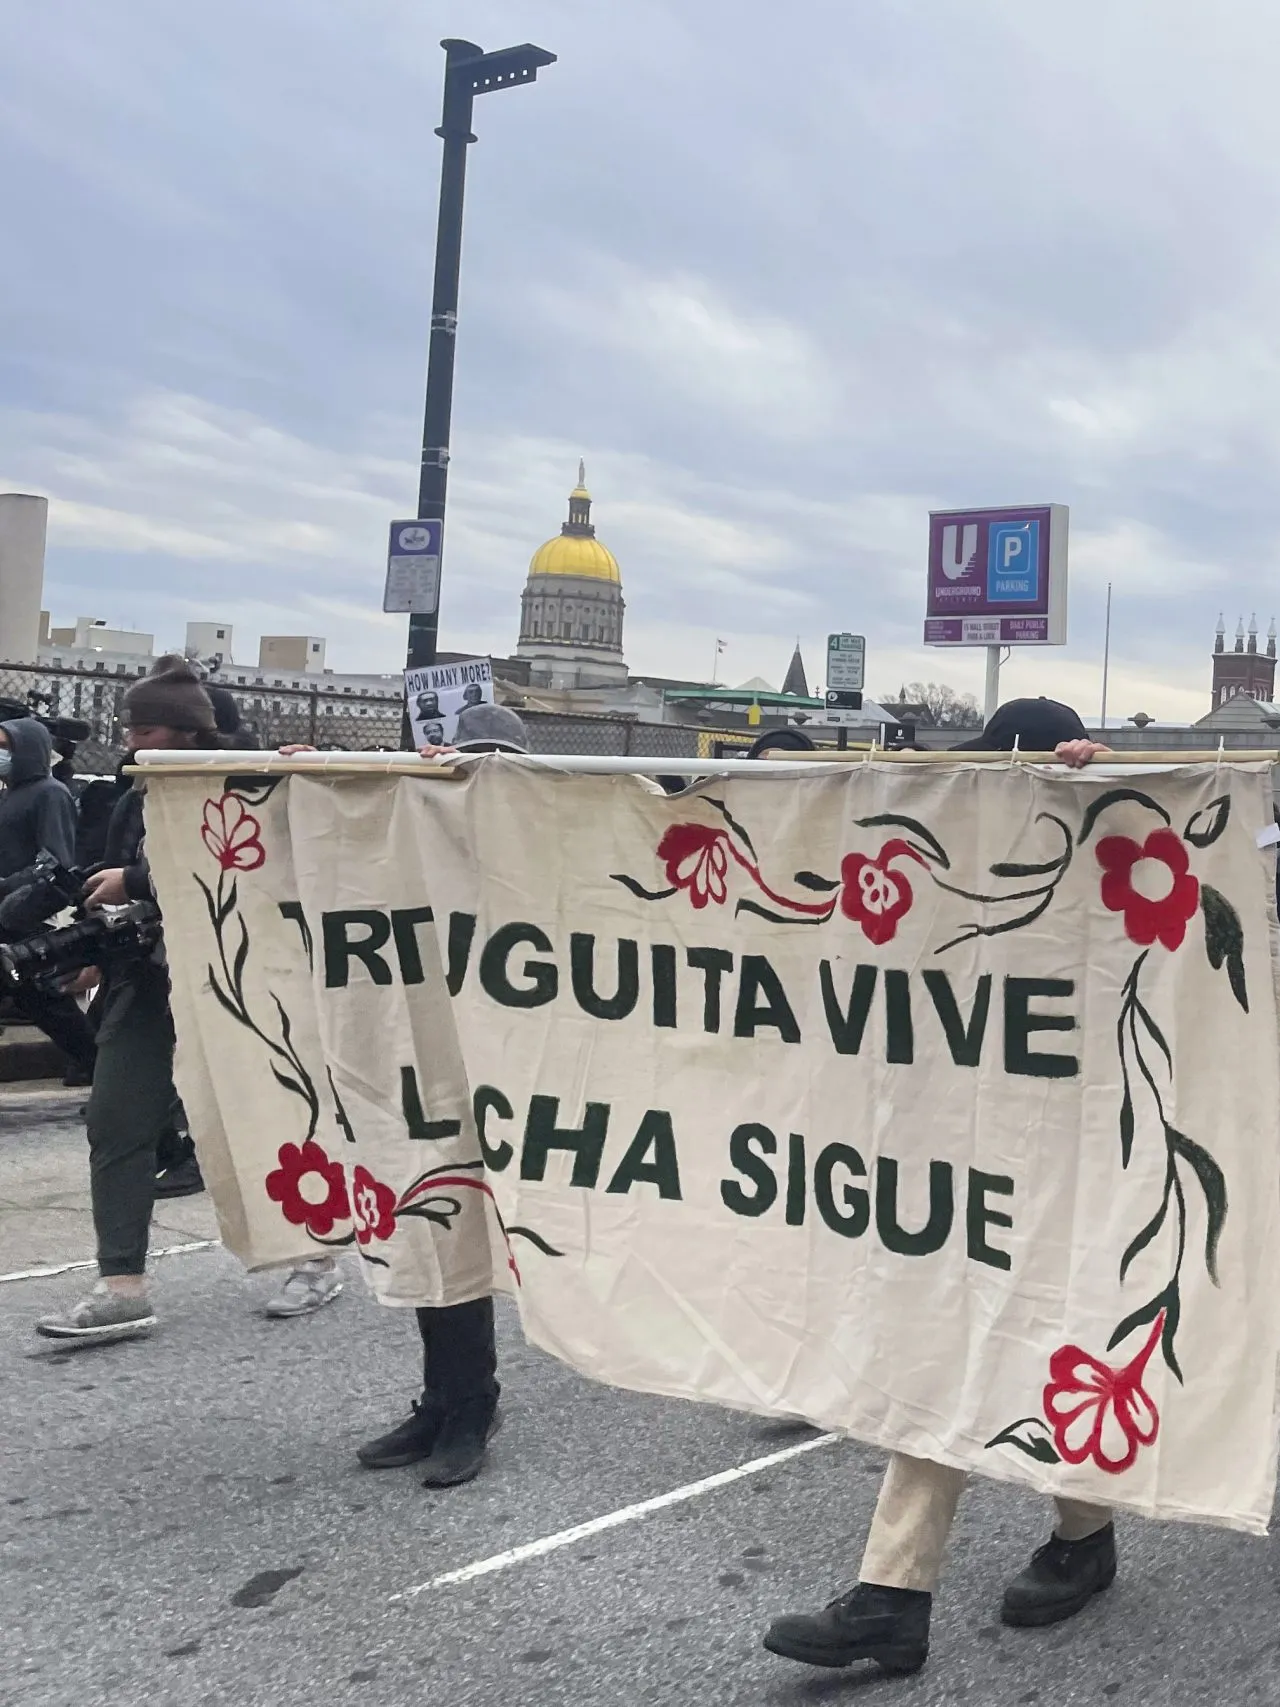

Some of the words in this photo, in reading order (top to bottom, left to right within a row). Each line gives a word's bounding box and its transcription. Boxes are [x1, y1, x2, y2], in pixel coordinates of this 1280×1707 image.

[1004, 537, 1022, 568] P
[935, 586, 981, 598] UNDERGROUND
[996, 580, 1030, 592] PARKING
[830, 637, 838, 650] 4
[407, 673, 429, 693] HOW
[431, 667, 458, 688] MANY
[461, 662, 491, 684] MORE?
[819, 958, 1079, 1079] VIVE
[720, 1122, 1015, 1271] SIGUE
